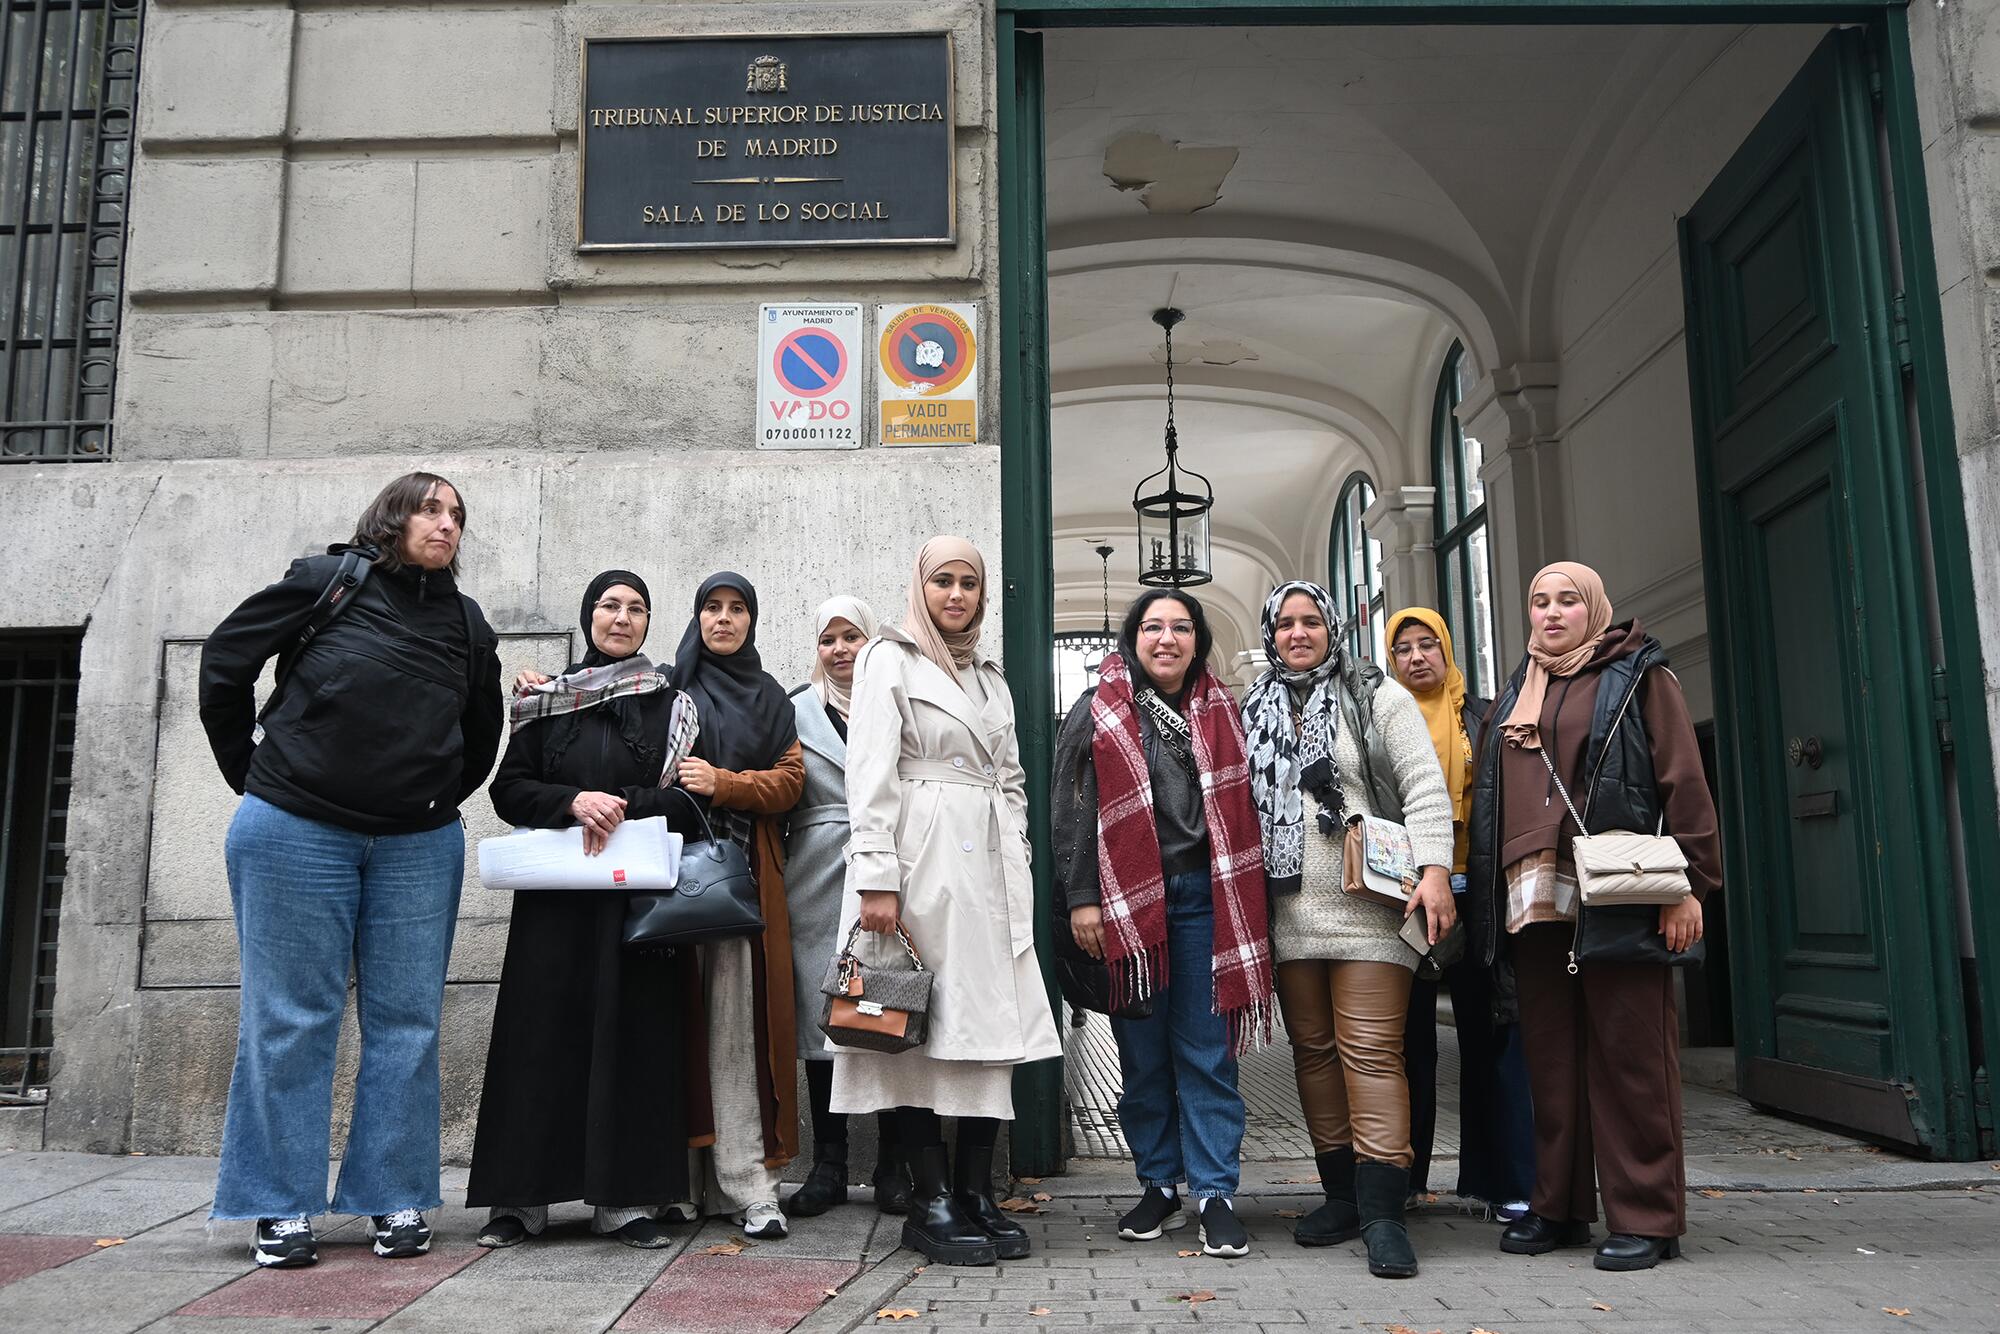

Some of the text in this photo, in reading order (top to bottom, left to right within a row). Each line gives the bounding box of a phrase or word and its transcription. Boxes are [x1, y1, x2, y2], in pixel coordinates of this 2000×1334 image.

[591, 102, 944, 127] TRIBUNAL SUPERIOR DE JUSTICIA
[697, 137, 838, 158] DE MADRID
[643, 201, 889, 223] SALA DE LO SOCIAL
[885, 306, 971, 335] SALIDA DE VEHICULOS
[907, 403, 947, 418] VADO
[766, 428, 852, 440] 0700001122
[885, 423, 972, 439] PERMANENTE
